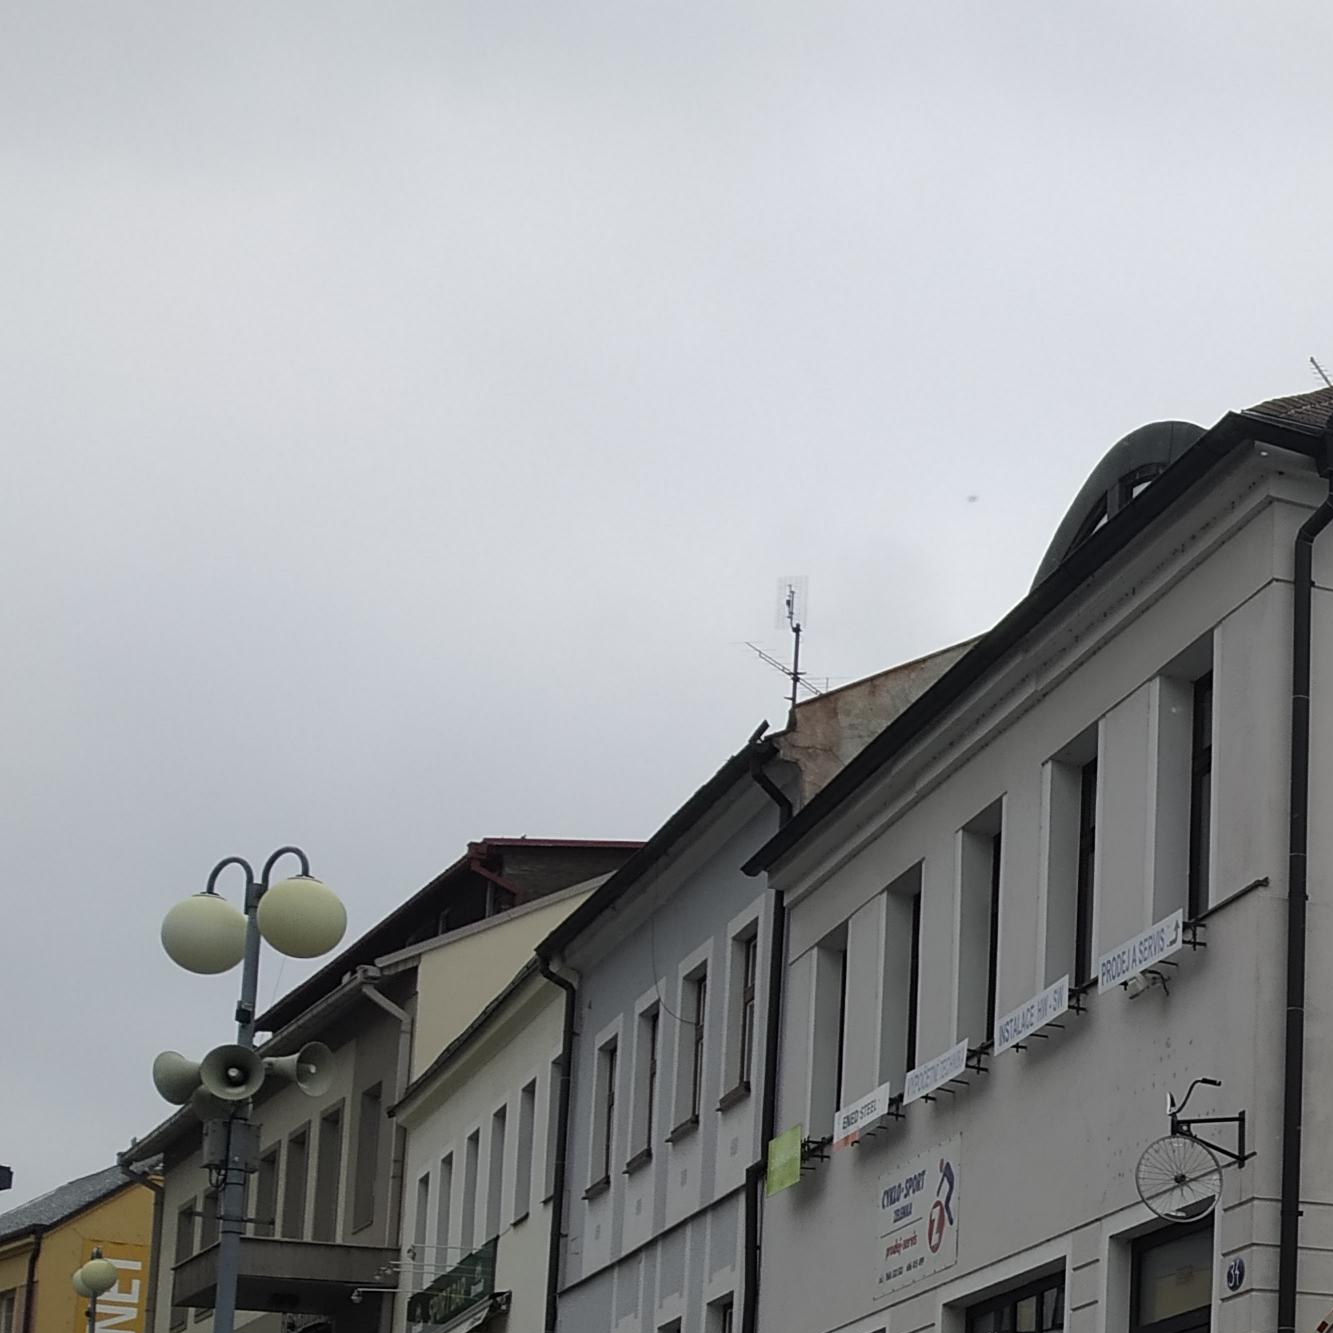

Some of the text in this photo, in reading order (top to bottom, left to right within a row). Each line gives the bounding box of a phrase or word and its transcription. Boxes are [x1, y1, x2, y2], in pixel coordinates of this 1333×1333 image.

[1101, 927, 1165, 986] PRODEJ A SERVIS
[998, 1003, 1036, 1048] INSTALACE
[842, 1109, 859, 1130] ENED
[1228, 1258, 1241, 1287] 34
